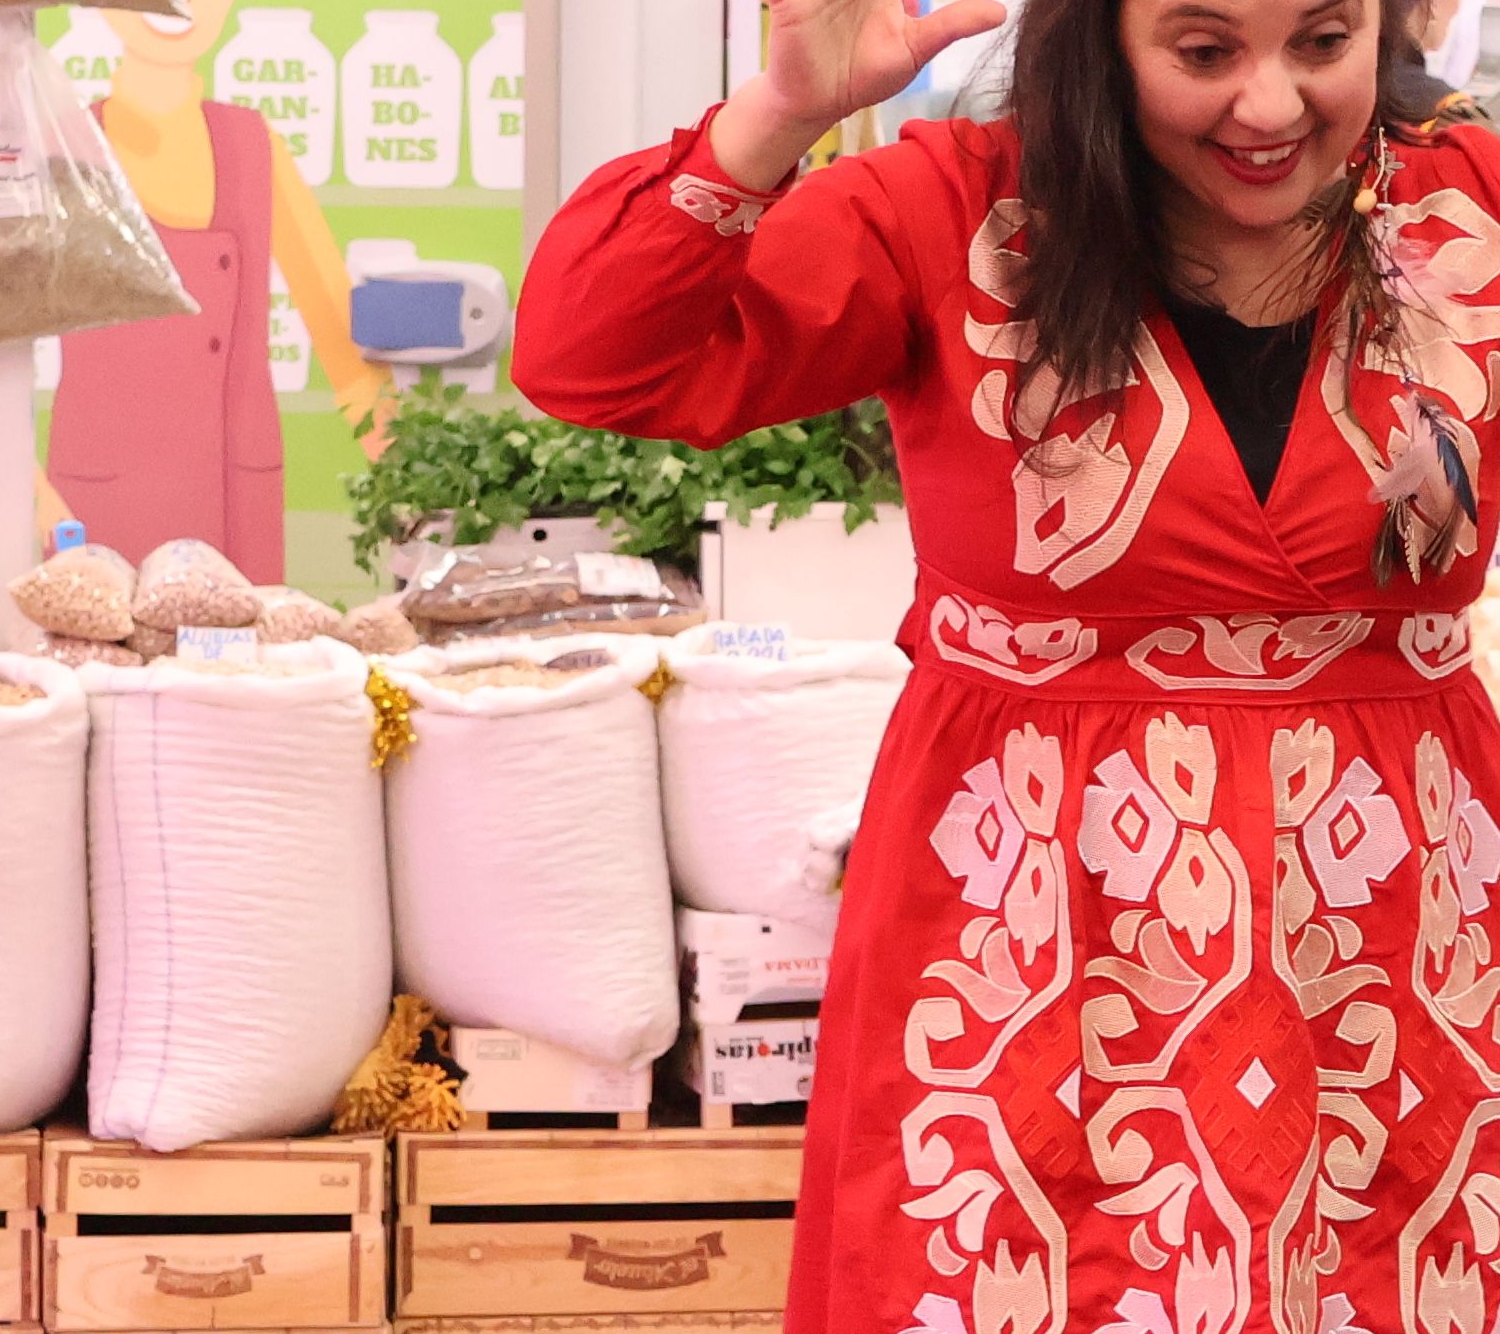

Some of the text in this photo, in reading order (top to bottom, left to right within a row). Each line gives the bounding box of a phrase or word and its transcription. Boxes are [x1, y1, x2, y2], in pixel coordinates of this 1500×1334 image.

[232, 58, 318, 83] GAR-
[371, 63, 433, 88] HA-
[372, 100, 432, 125] BO-
[365, 137, 438, 162] NES
